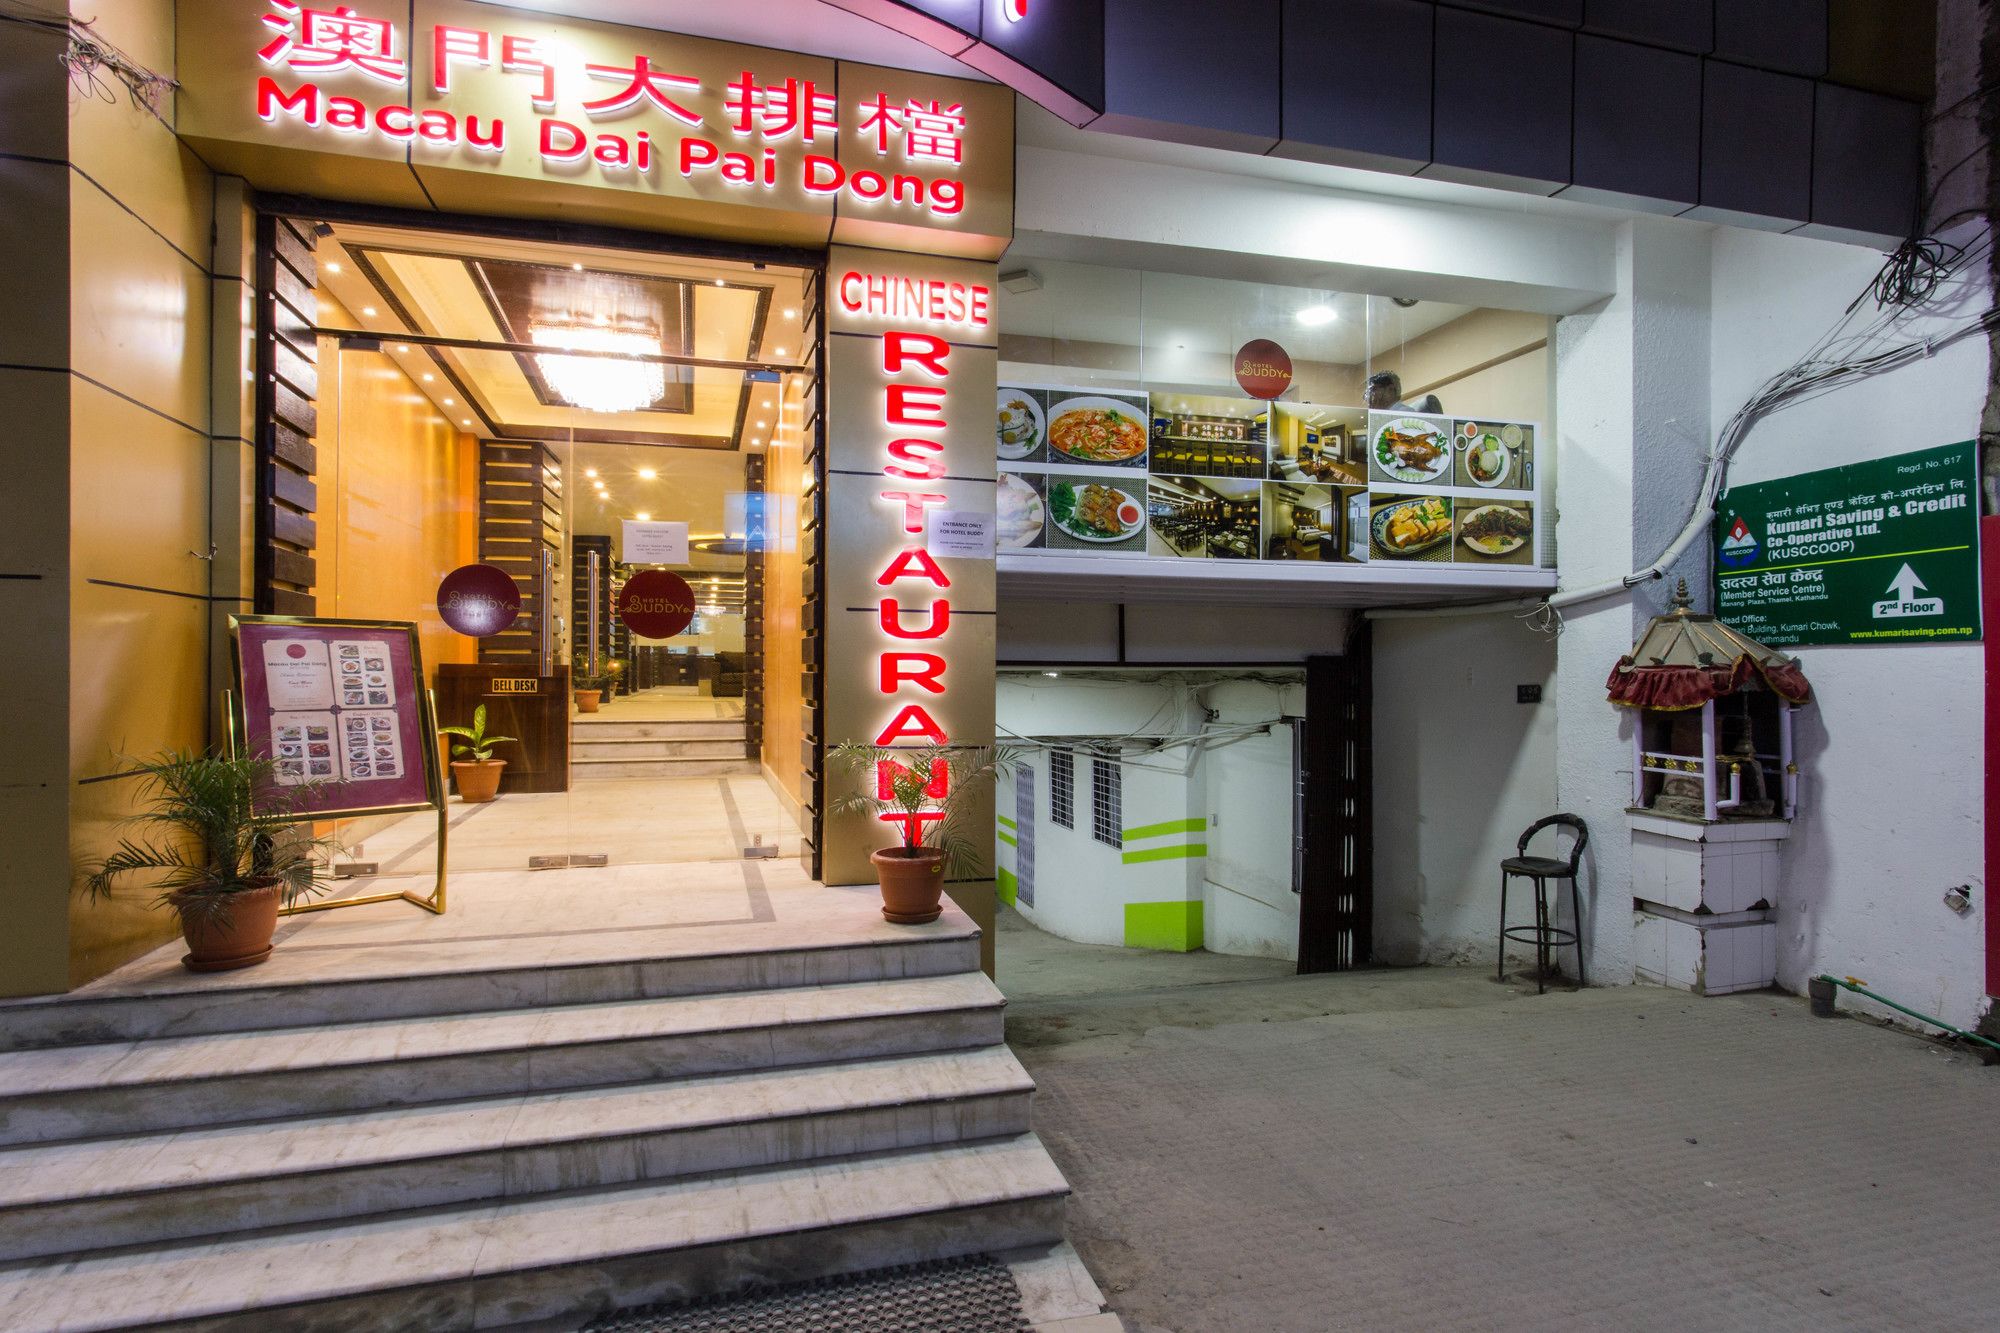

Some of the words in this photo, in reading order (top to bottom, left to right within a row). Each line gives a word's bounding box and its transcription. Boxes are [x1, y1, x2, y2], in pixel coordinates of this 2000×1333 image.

[257, 76, 505, 152] Macau
[539, 119, 651, 172] Dai
[679, 138, 777, 188] Pai
[802, 156, 966, 217] Dong
[840, 271, 989, 327] CHINESE
[1242, 360, 1285, 378] BUDDY
[1897, 463, 1923, 474] Regd.
[1926, 460, 1941, 470] No.
[1944, 455, 1962, 465] 617
[1766, 515, 1823, 536] Kumari
[1826, 507, 1885, 527] Saving
[1888, 505, 1901, 518] &
[1905, 493, 1967, 516] Credit
[1766, 528, 1853, 548] Co-Operative
[1855, 522, 1881, 536] Ltd.
[1767, 540, 1855, 562] (KUSCCOOP)
[1720, 576, 1759, 590] सदस्य
[1761, 571, 1787, 586] सेवा
[1790, 568, 1824, 582] केन्द्र
[875, 331, 951, 848] RESTAURANT
[1720, 588, 1755, 601] (Member
[1757, 586, 1790, 598] Service
[1791, 583, 1825, 595] Centre)
[629, 595, 684, 613] BUDDY
[1879, 602, 1898, 615] 2nd
[1902, 603, 1936, 613] Floor
[1721, 616, 1740, 625] Head
[1741, 614, 1767, 623] Office:
[1780, 622, 1809, 632] Kumari
[1809, 621, 1841, 631] Chowk,
[1850, 627, 1973, 639] www.kumarisaving.com.np
[493, 680, 513, 691] BELL
[514, 680, 536, 691] DESK
